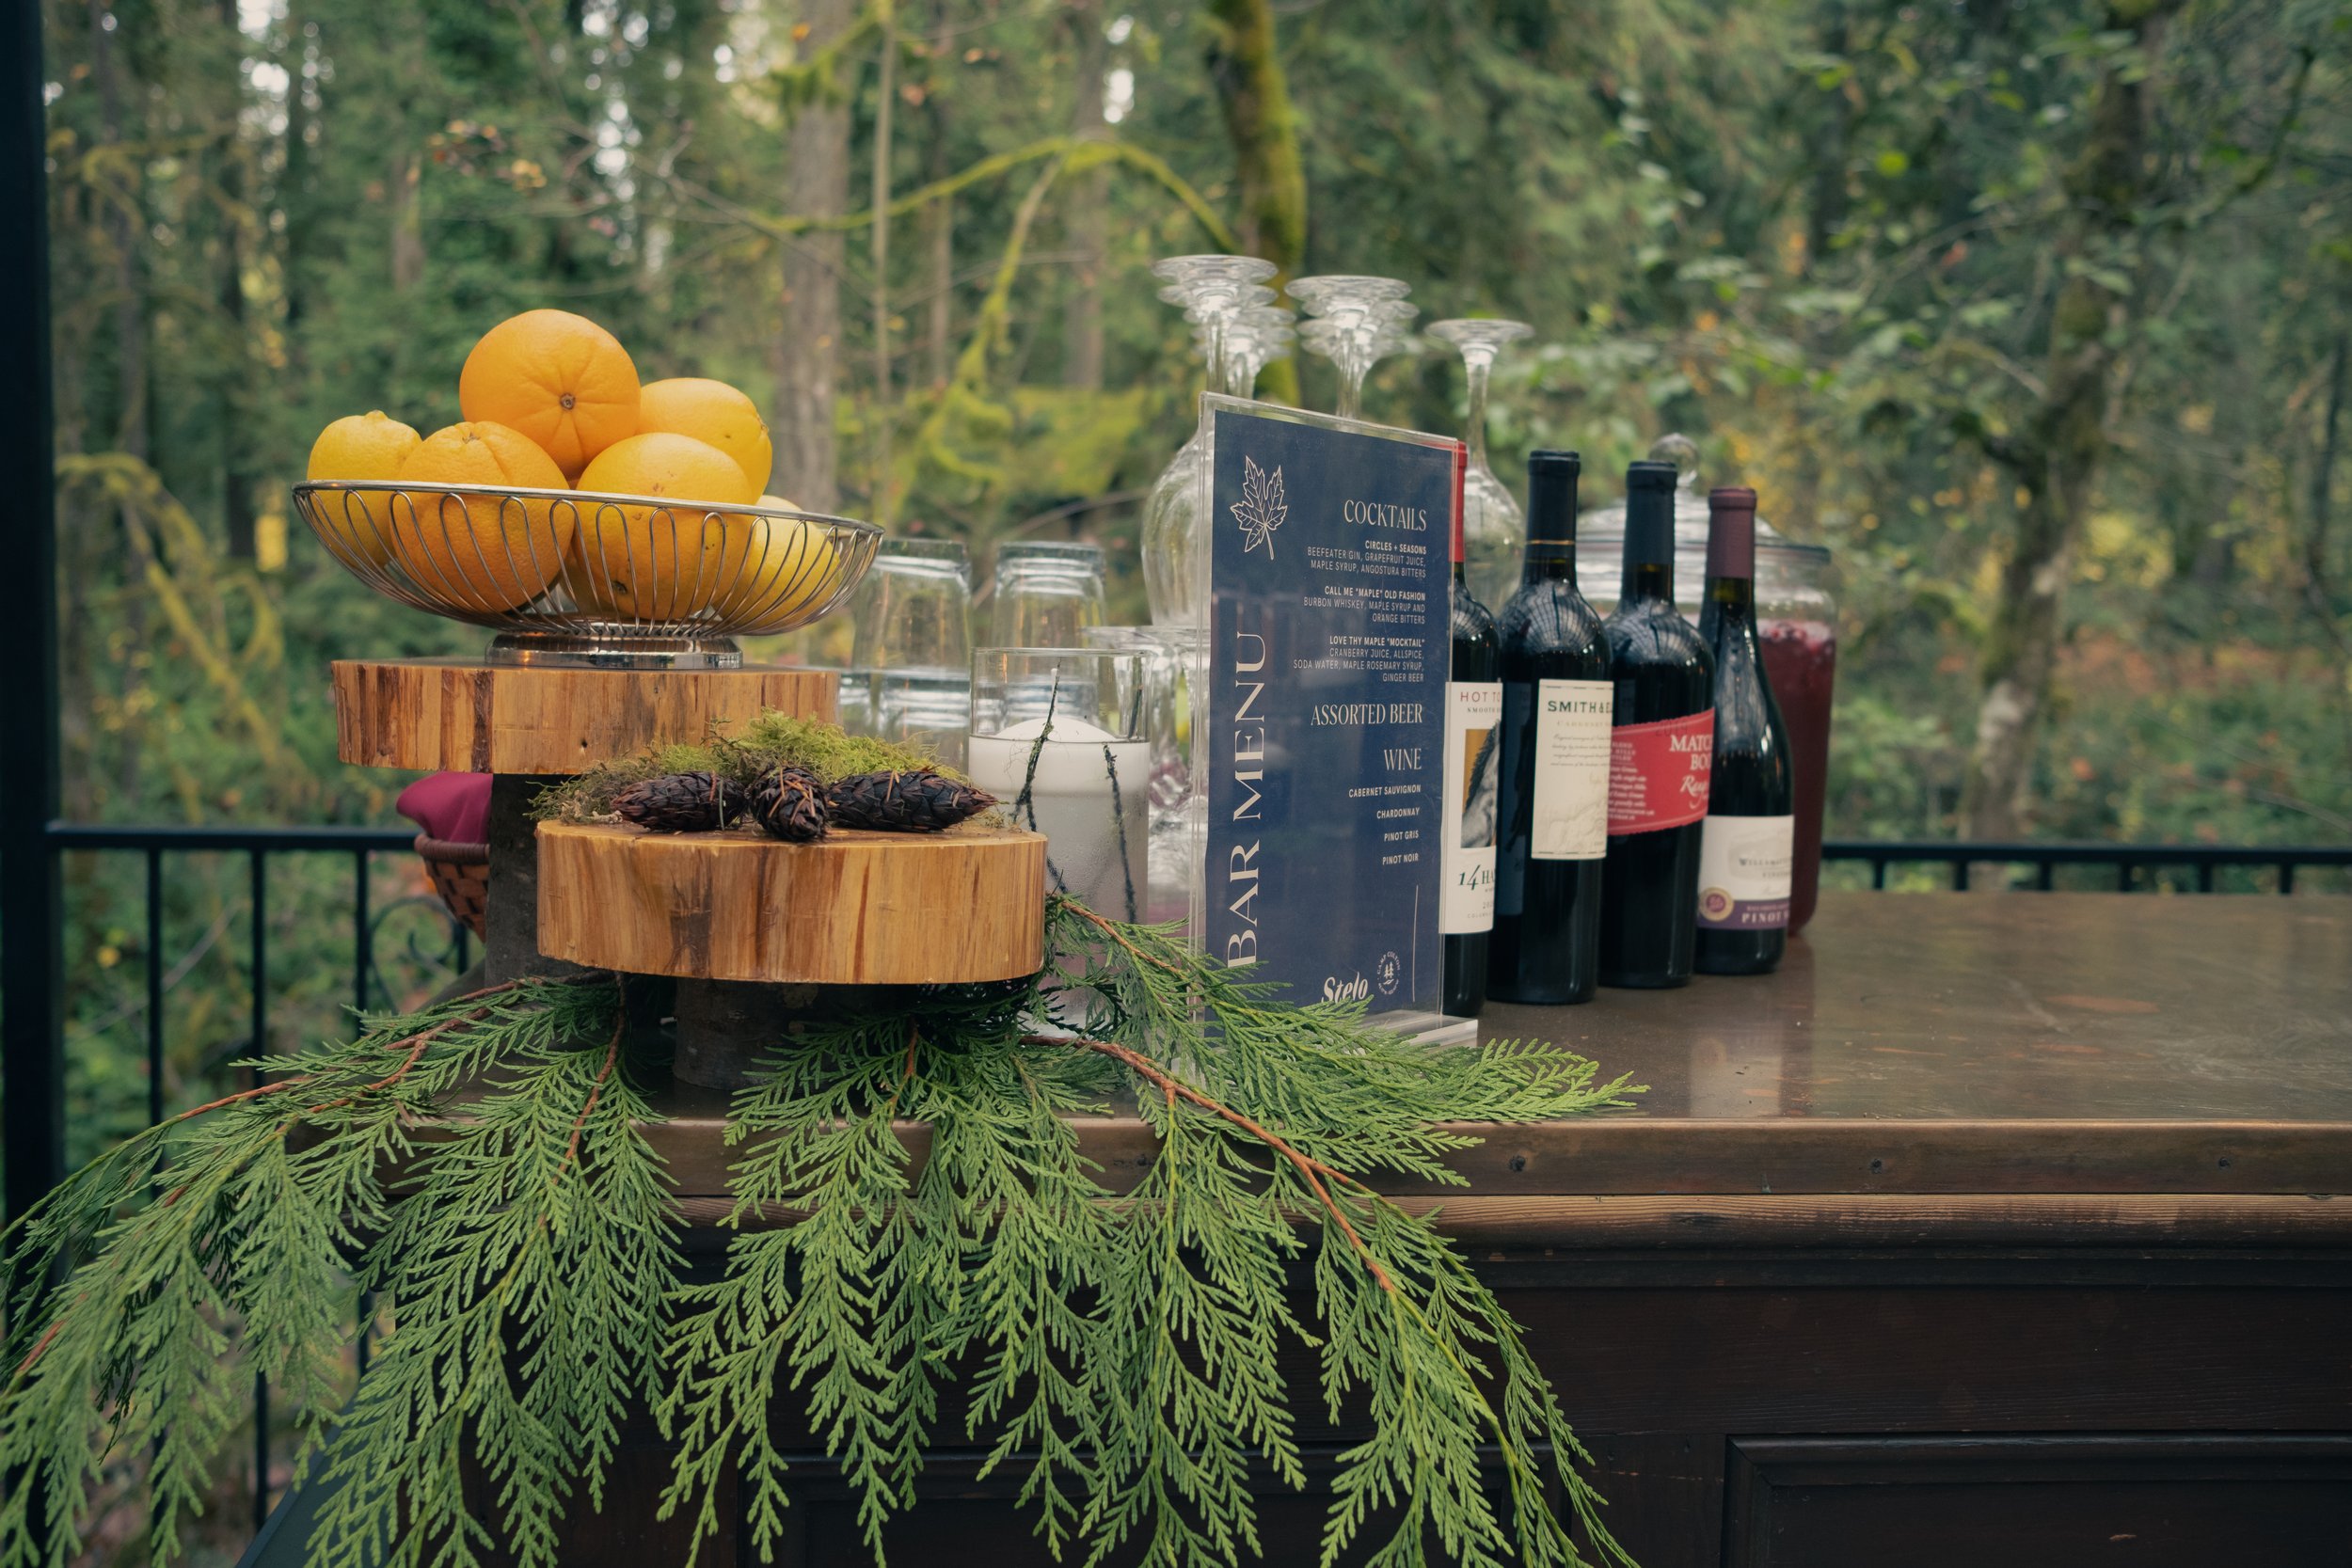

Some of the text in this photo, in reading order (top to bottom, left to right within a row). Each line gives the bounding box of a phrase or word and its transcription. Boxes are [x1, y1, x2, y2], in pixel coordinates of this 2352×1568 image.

[1343, 499, 1427, 531] COCKTAILS
[1364, 540, 1392, 551] CIRCLES
[1399, 544, 1427, 555] SEASONS
[1307, 546, 1426, 567] BEEFEATER GIN, GRAPEFRUIT JUICE,
[1311, 560, 1426, 578] MAPLE SYRUP, ANGOSTURA BITTERS
[1324, 585, 1342, 595] CALL
[1343, 587, 1354, 596] ME
[1384, 590, 1397, 599] OLD
[1398, 591, 1426, 601] FASHION
[1303, 596, 1332, 608] BURBON
[1368, 601, 1391, 611] MAPLE
[1391, 602, 1411, 612] SYRUP
[1412, 603, 1425, 613] AND
[1372, 612, 1425, 625] ORANGE BITTERS
[1329, 635, 1347, 645] LOVE
[1348, 636, 1362, 645] THY
[1363, 637, 1386, 646] MAPLE
[1329, 647, 1424, 660] CRANBERRY JUICE, ALLSPICE,
[1293, 659, 1424, 672] SODA WATER, MAPLE ROSEMARY SYRUP,
[1382, 673, 1424, 682] GINGER BEER
[1460, 691, 1488, 702] HOT
[1547, 700, 1597, 713] SMITH
[1311, 704, 1422, 726] ASSORTED BEER
[1669, 735, 1712, 752] MATC
[1384, 748, 1422, 771] WINE
[1690, 753, 1711, 770] BO
[1348, 784, 1422, 799] CABERNET SAUVIGNON
[1227, 631, 1265, 968] BAR MENU
[1376, 807, 1421, 819] CHARDONNAY
[1384, 830, 1419, 842] PINOT GRIS
[1382, 852, 1419, 865] PINOT NOIR
[1457, 863, 1481, 891] 14
[1741, 911, 1782, 924] PINOT
